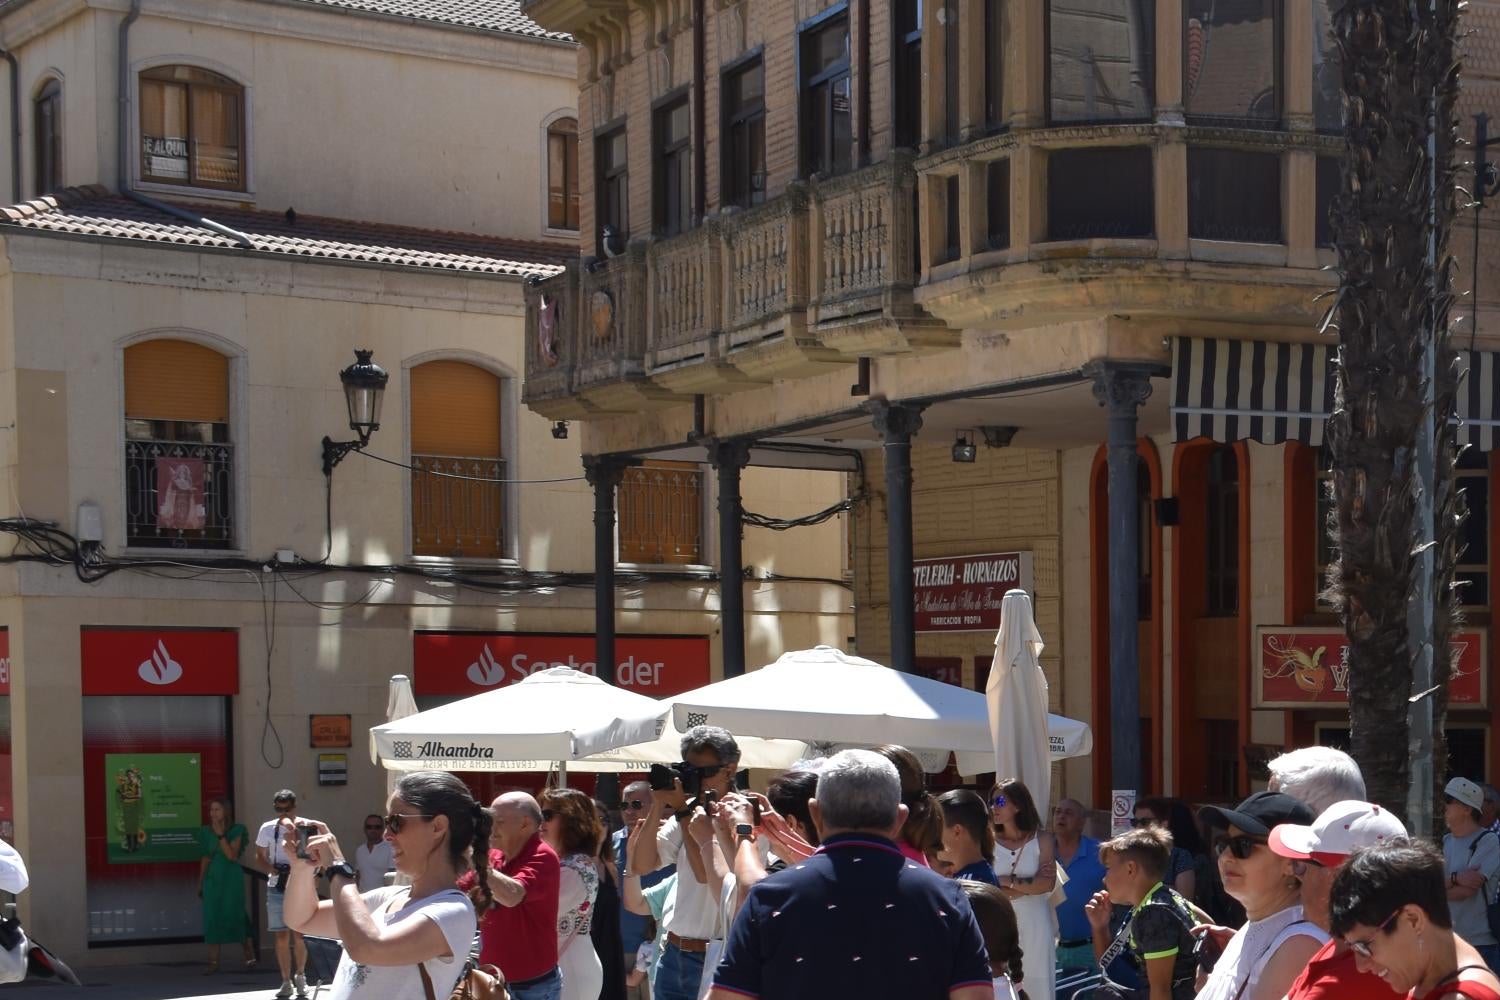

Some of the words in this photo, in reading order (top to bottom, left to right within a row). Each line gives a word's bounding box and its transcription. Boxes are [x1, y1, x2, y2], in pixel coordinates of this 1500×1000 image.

[963, 559, 1018, 584] HORNAZOS
[930, 616, 961, 626] FABRICACION
[963, 615, 982, 625] PROPIA
[416, 741, 494, 759] Alhambra
